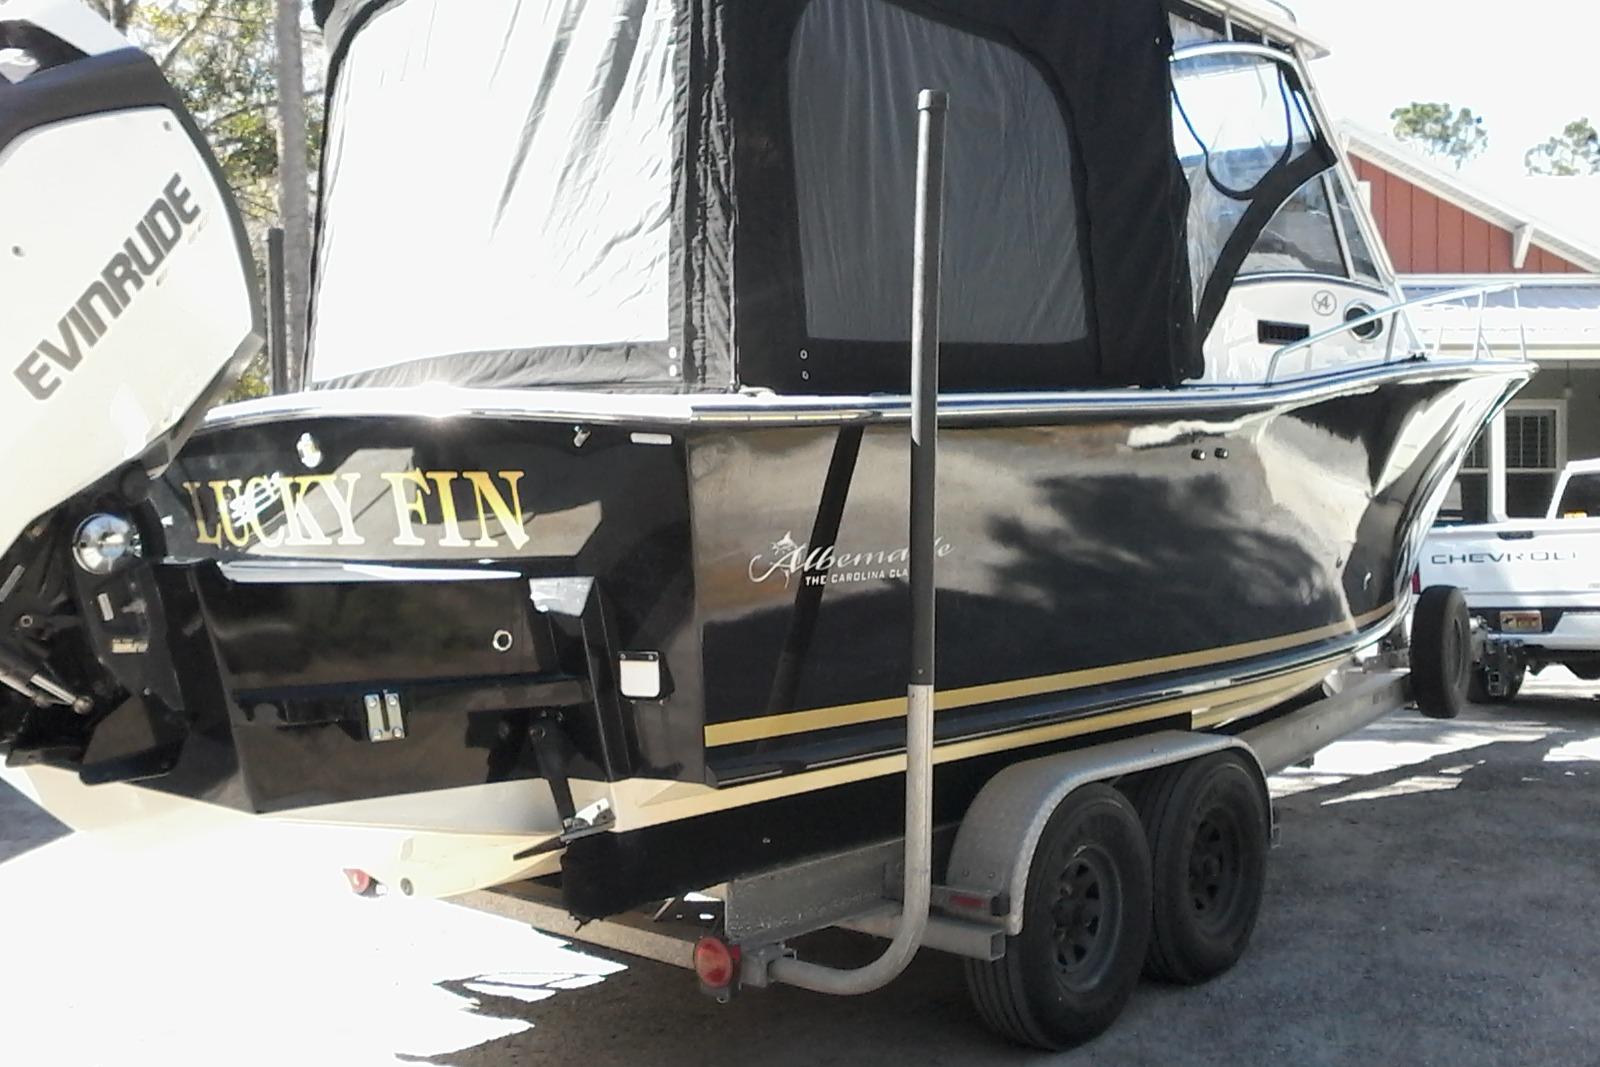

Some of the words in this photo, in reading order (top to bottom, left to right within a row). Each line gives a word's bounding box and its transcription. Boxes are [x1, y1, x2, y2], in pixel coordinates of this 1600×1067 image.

[13, 172, 201, 400] EVINRUDE
[182, 472, 365, 549] LUCKY
[380, 467, 531, 551] FIN
[749, 535, 954, 583] Albemae
[805, 574, 827, 586] THE
[831, 569, 886, 585] CAROLINA
[1431, 551, 1577, 565] CHEVROL
